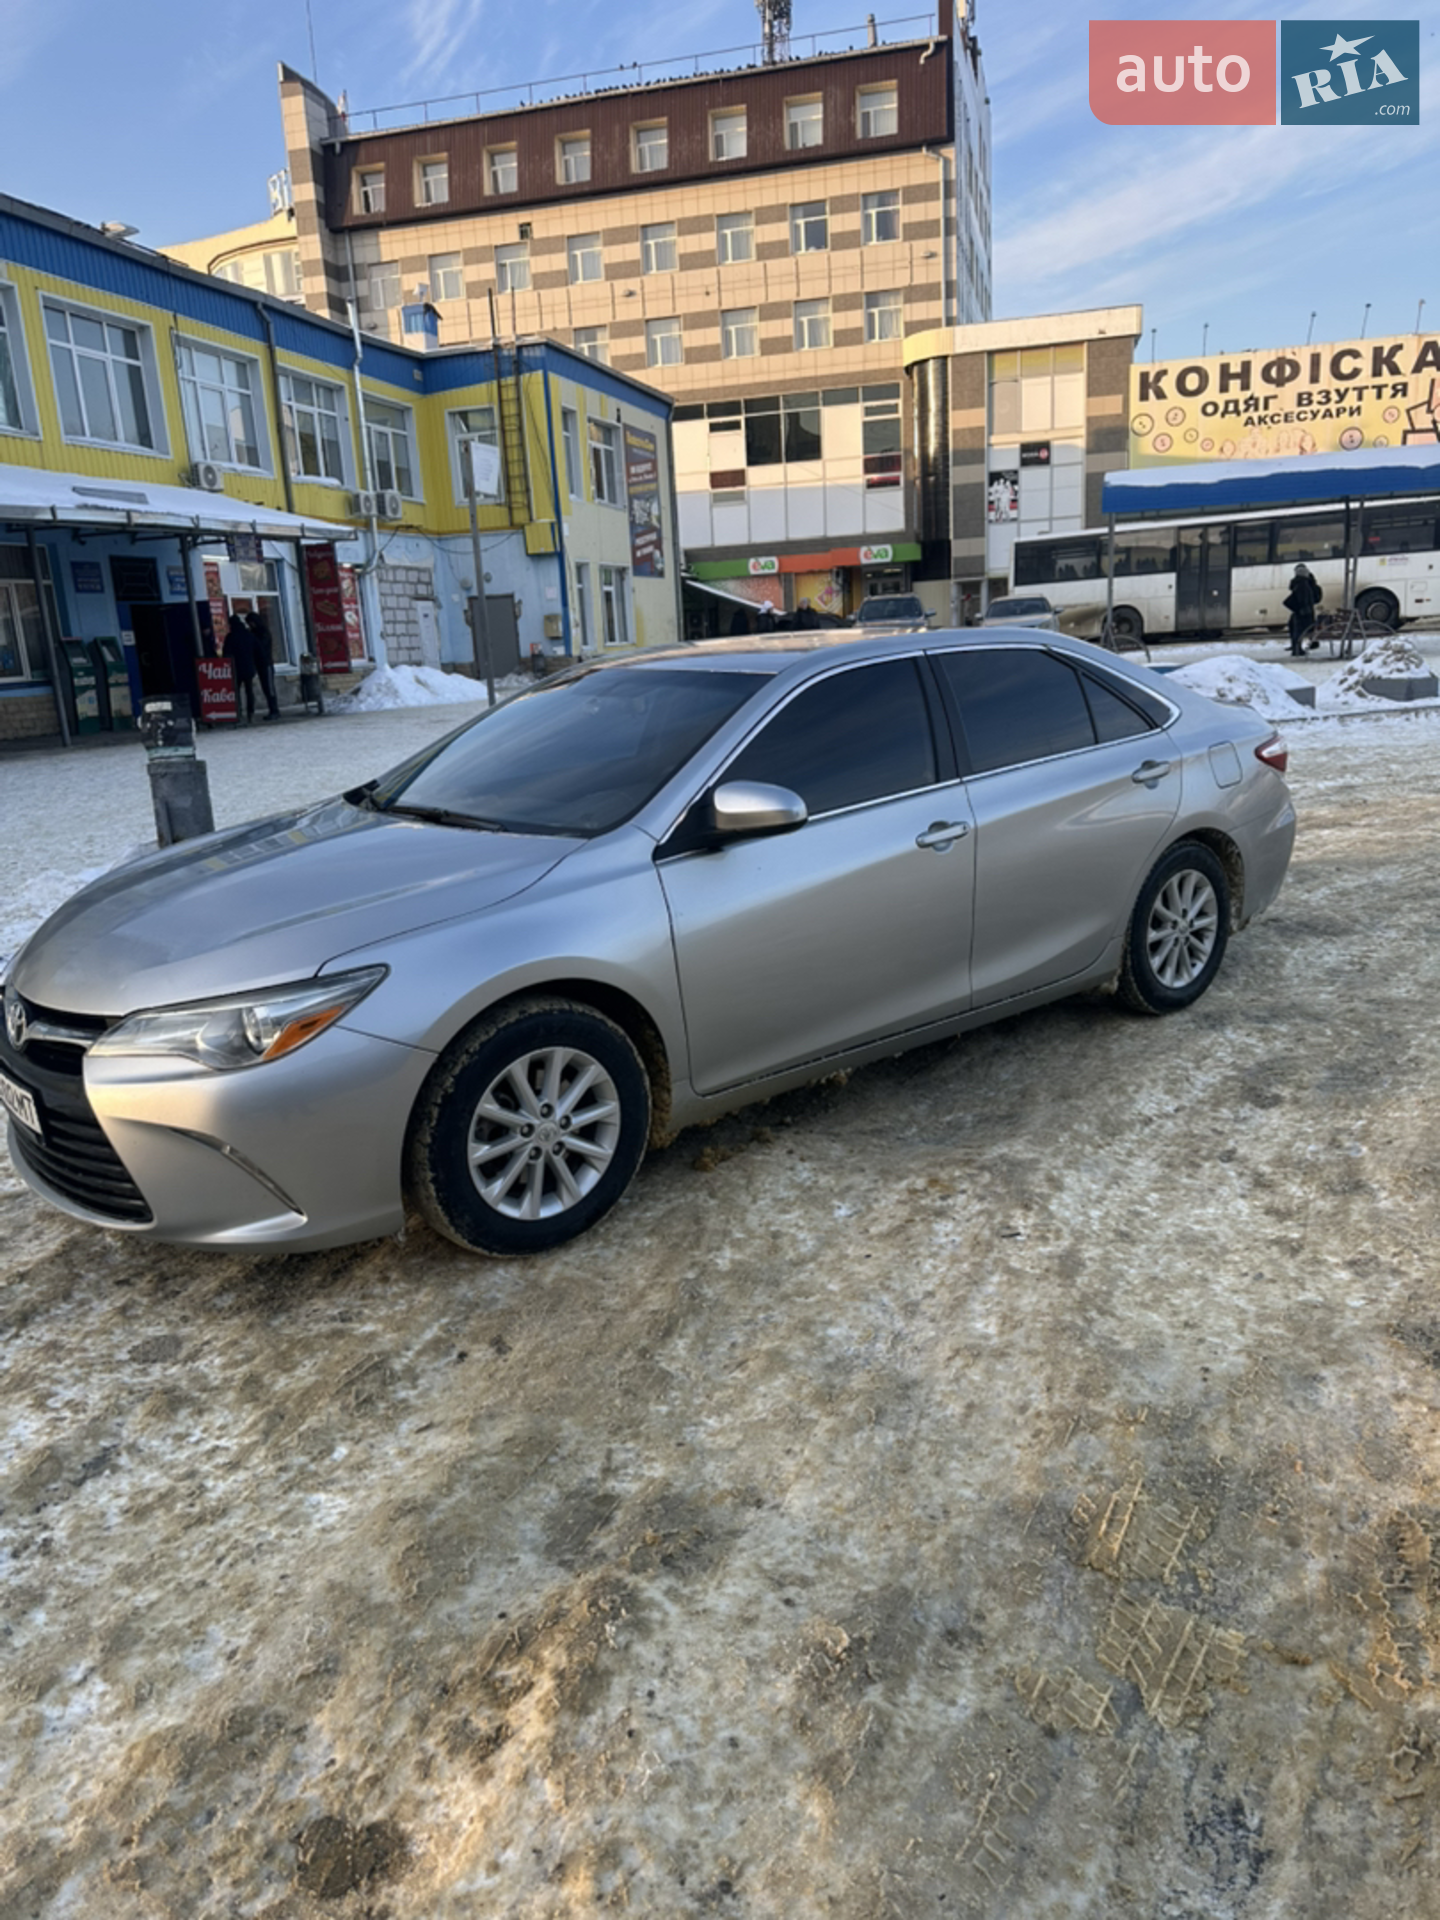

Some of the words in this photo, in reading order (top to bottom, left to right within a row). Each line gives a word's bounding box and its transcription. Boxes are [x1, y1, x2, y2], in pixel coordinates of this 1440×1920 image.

[1139, 340, 1440, 402] КОНФІСКА
[1200, 394, 1279, 419] ОДЯГ
[1296, 381, 1409, 408] ВЗУТТЯ
[1243, 405, 1362, 428] АКСЕСУАРИ
[199, 662, 232, 680] Чай
[200, 687, 236, 703] Кава
